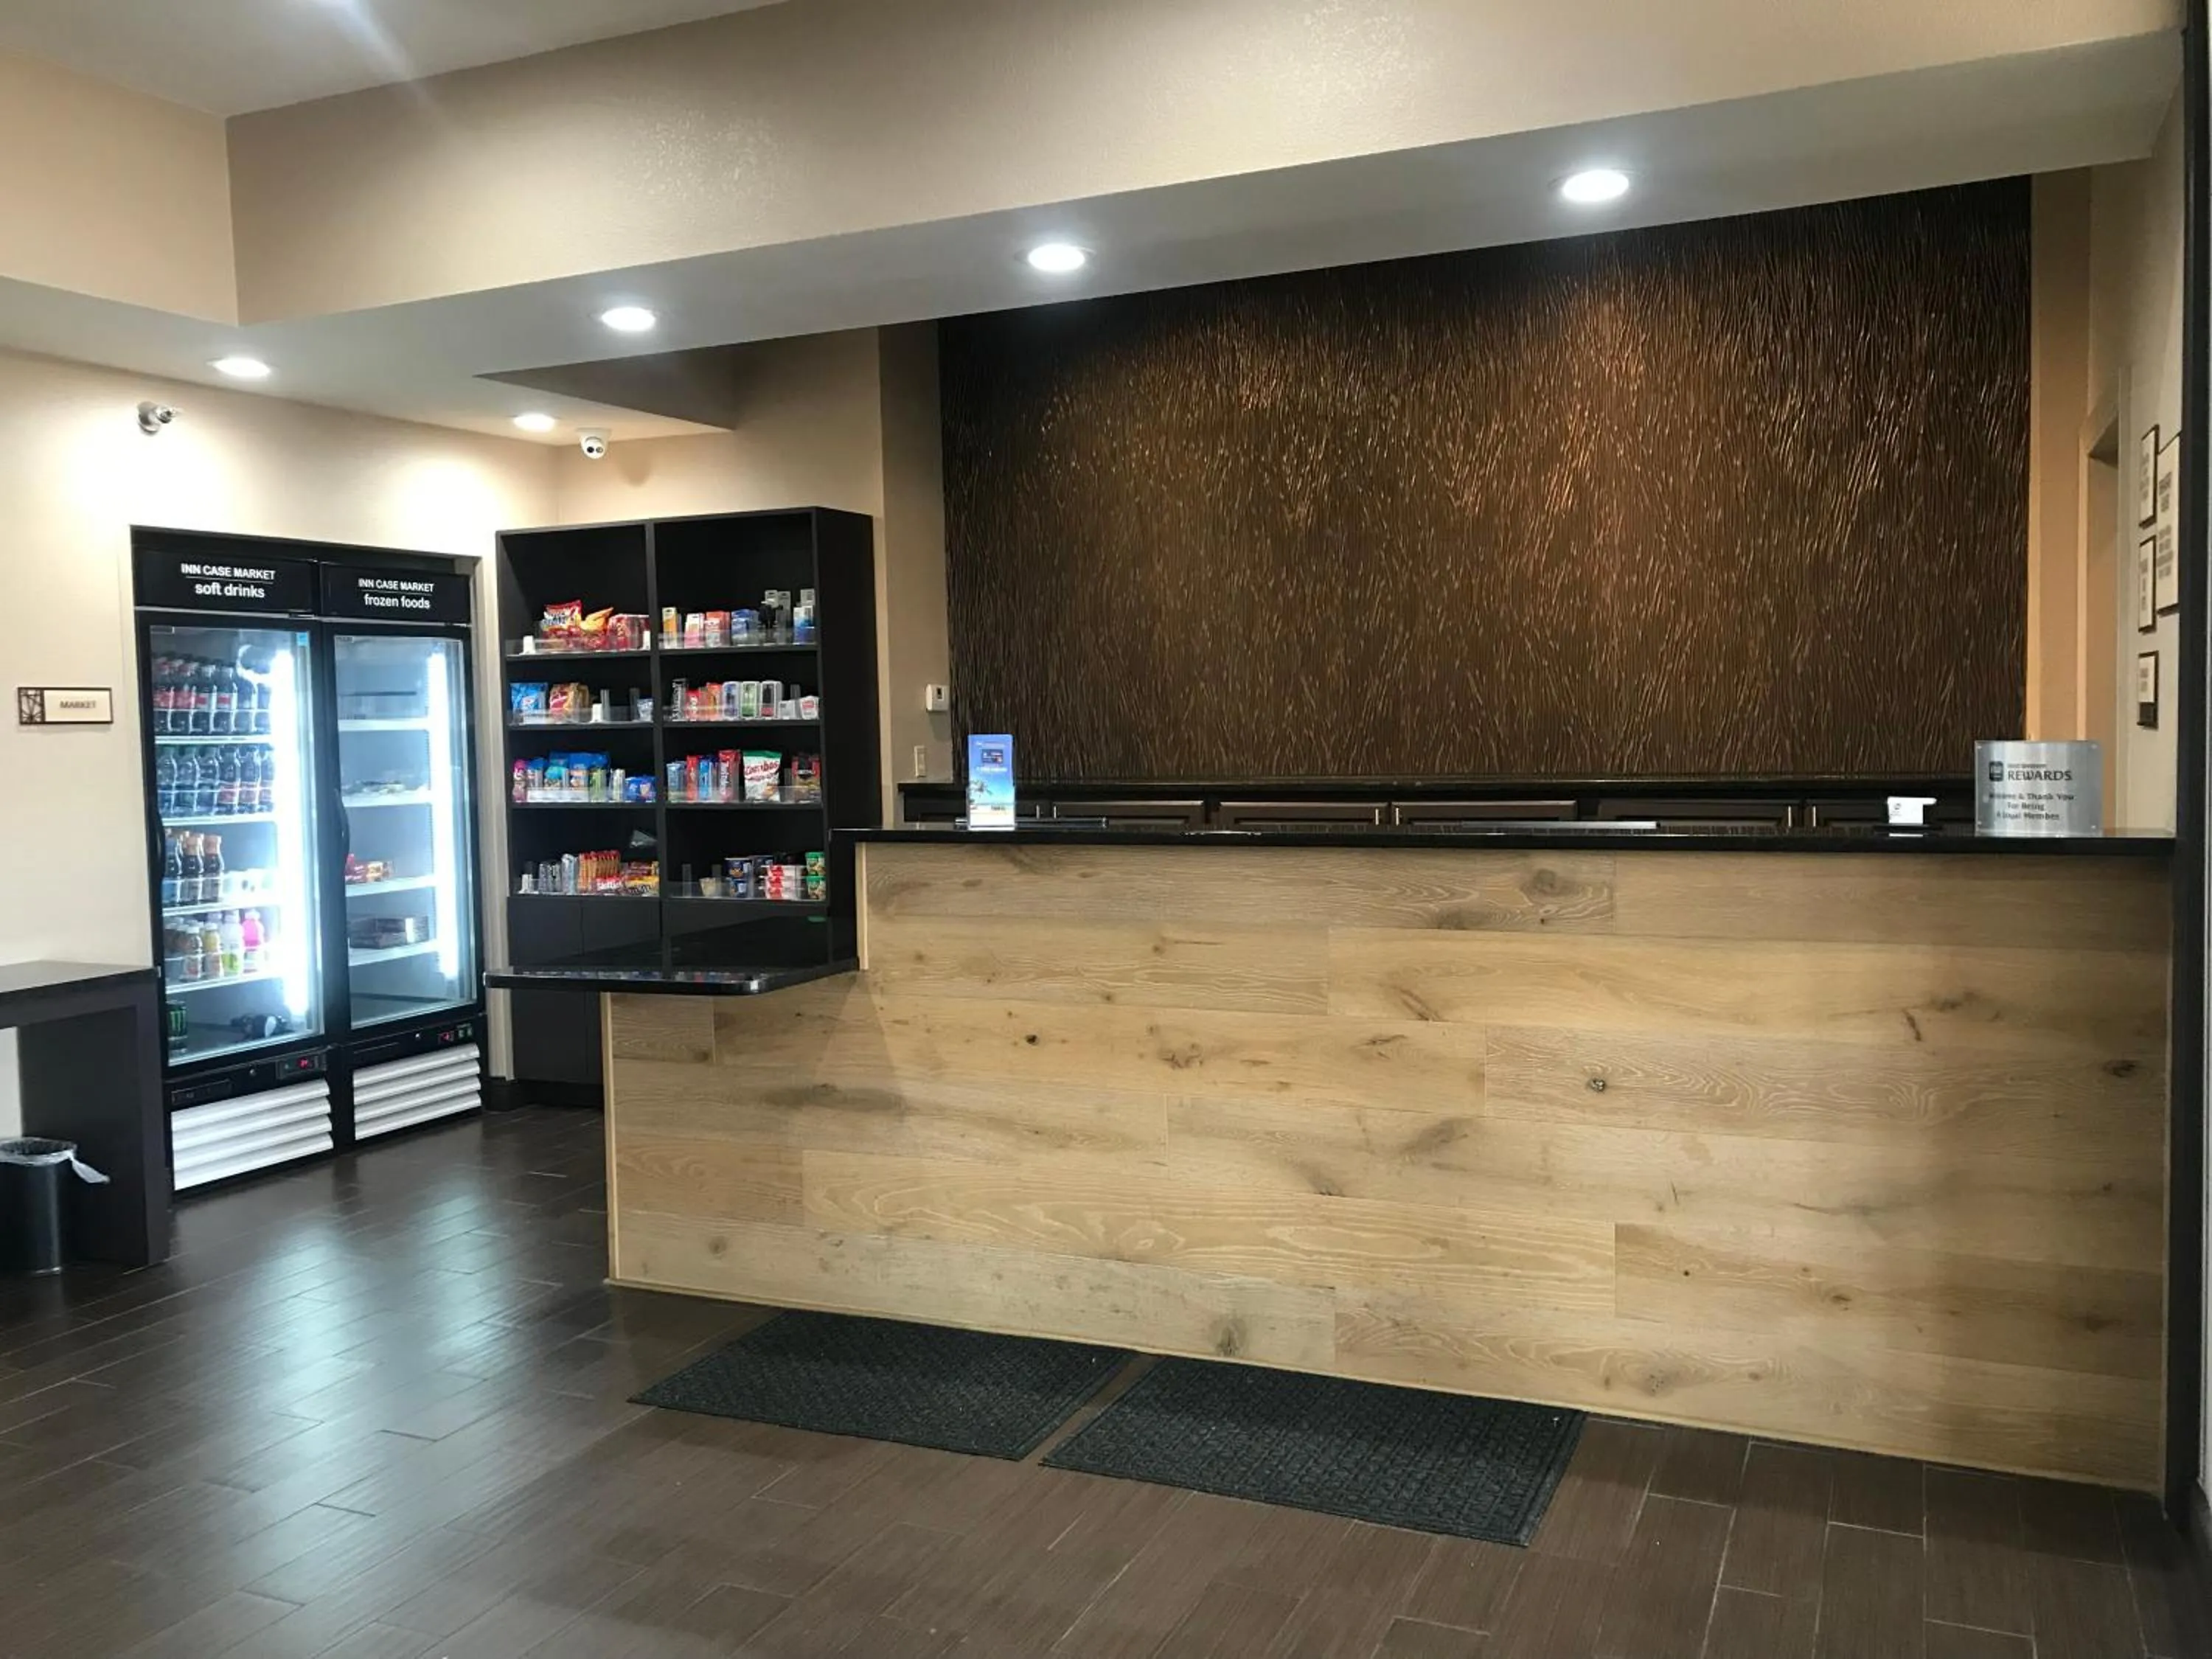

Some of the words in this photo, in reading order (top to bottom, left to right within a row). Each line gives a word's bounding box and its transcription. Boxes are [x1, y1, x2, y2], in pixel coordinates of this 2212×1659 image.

[181, 563, 201, 574] INN
[203, 565, 232, 577] CASE
[233, 567, 276, 580] MARKET
[195, 582, 222, 596] soft
[223, 583, 265, 598] drinks
[358, 577, 375, 588] INN
[375, 580, 398, 590] CASE
[400, 581, 434, 592] MARKET
[364, 593, 399, 607] frozen
[400, 595, 431, 609] foods
[60, 700, 96, 709] MARKET
[2007, 770, 2073, 781] REWARDS
